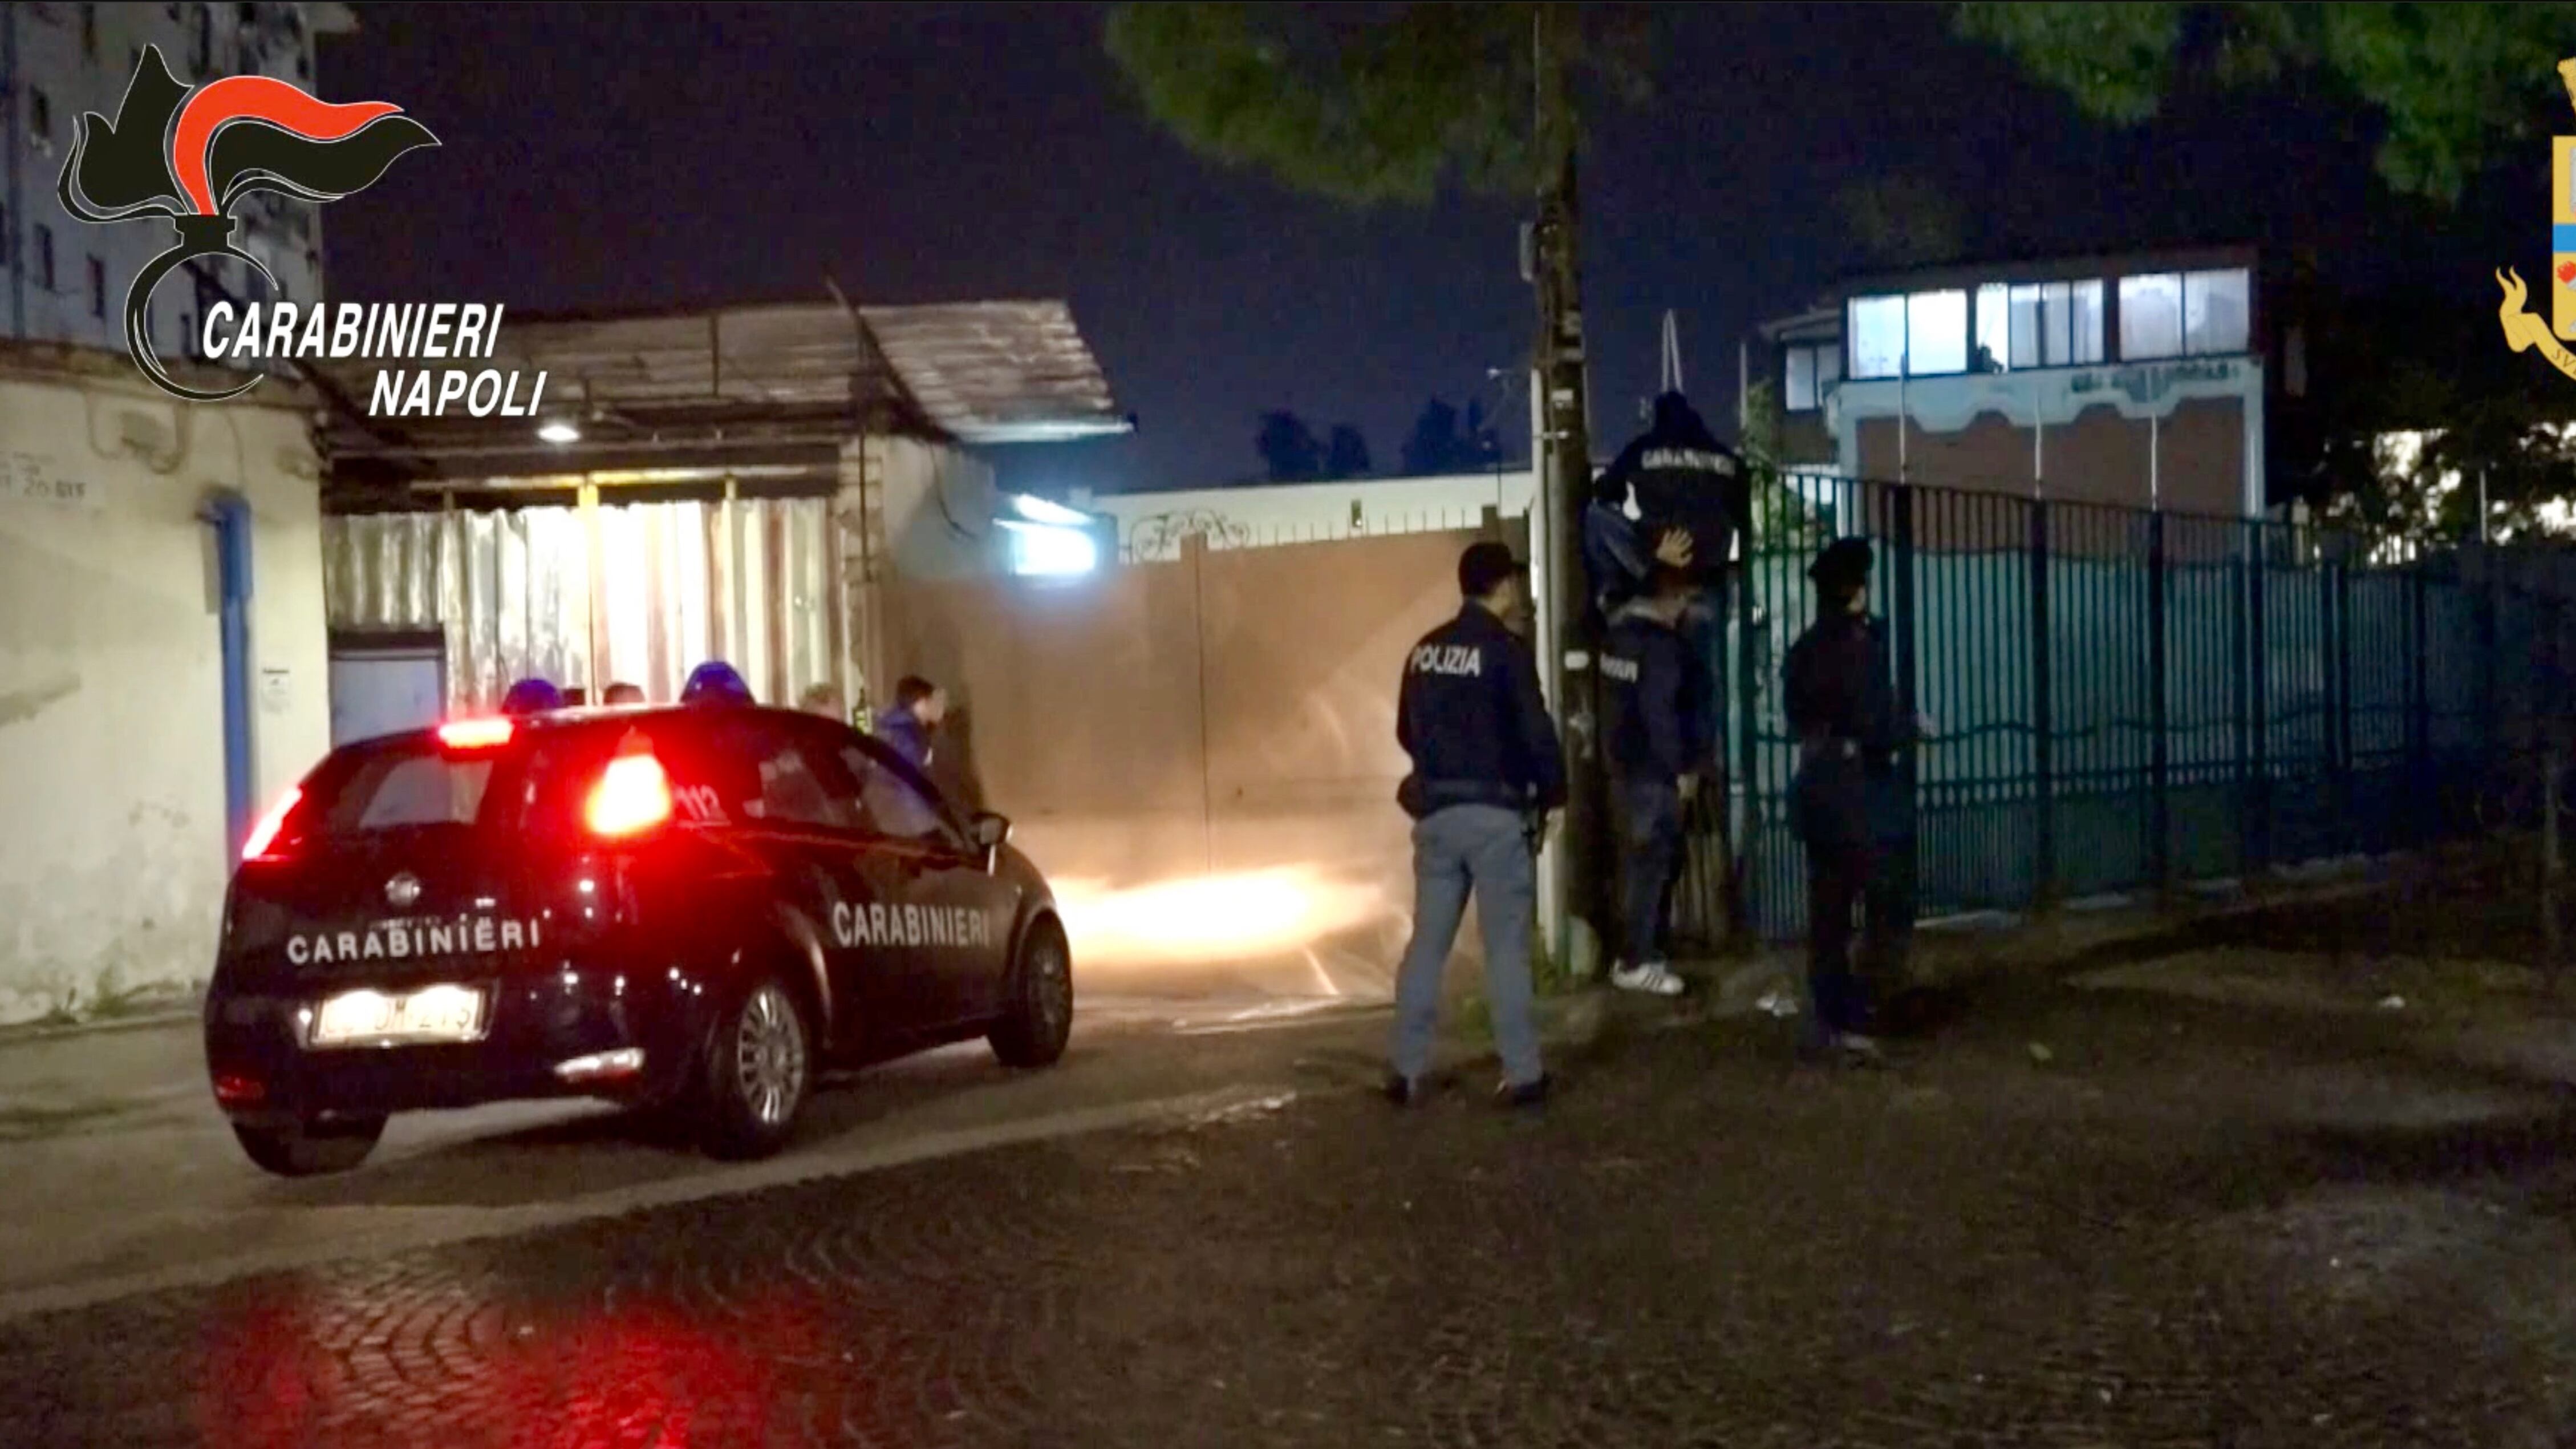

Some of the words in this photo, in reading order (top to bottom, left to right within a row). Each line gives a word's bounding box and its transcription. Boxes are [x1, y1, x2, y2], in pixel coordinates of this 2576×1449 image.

[1410, 644, 1480, 677] POLIZIA
[287, 917, 540, 964] CARABINIERI
[833, 901, 990, 949] CARABINIERI
